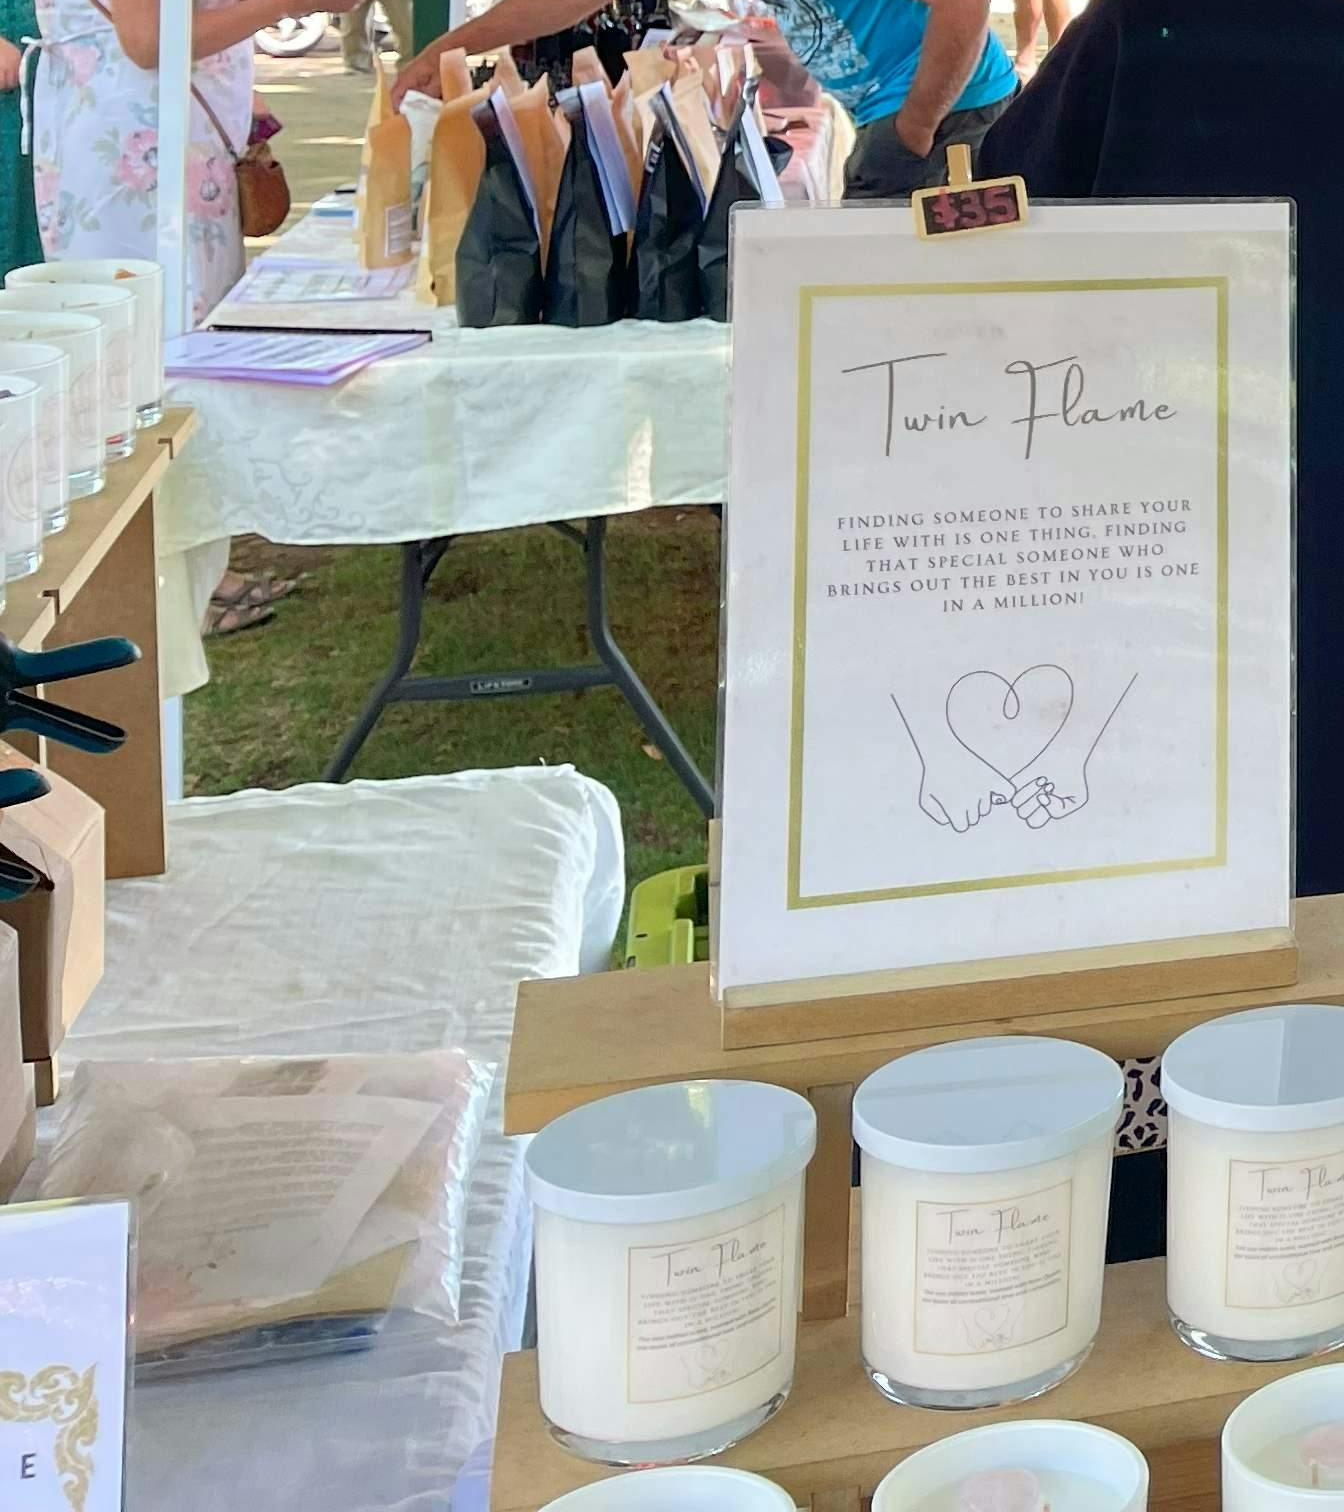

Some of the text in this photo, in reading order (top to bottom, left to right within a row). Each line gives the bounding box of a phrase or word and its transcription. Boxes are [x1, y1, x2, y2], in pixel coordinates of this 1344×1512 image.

[930, 185, 1018, 228] $35
[842, 353, 1177, 459] Twin Flame
[837, 499, 1192, 531] FINDING SOMEONE TO SHARE YOUR
[842, 520, 1187, 552] LIFE WITH IS ONE THING, FINDING
[865, 543, 1164, 574] THAT SPECIAL SOMEONE WHO
[827, 562, 1199, 598] BRINGS OUT THE BEST IN YOU IS ONE
[943, 591, 1084, 613] IN A MILLION!
[1248, 1167, 1294, 1201] Twin
[936, 1206, 1049, 1245] Twin Flame
[650, 1238, 767, 1287] Twin Flame
